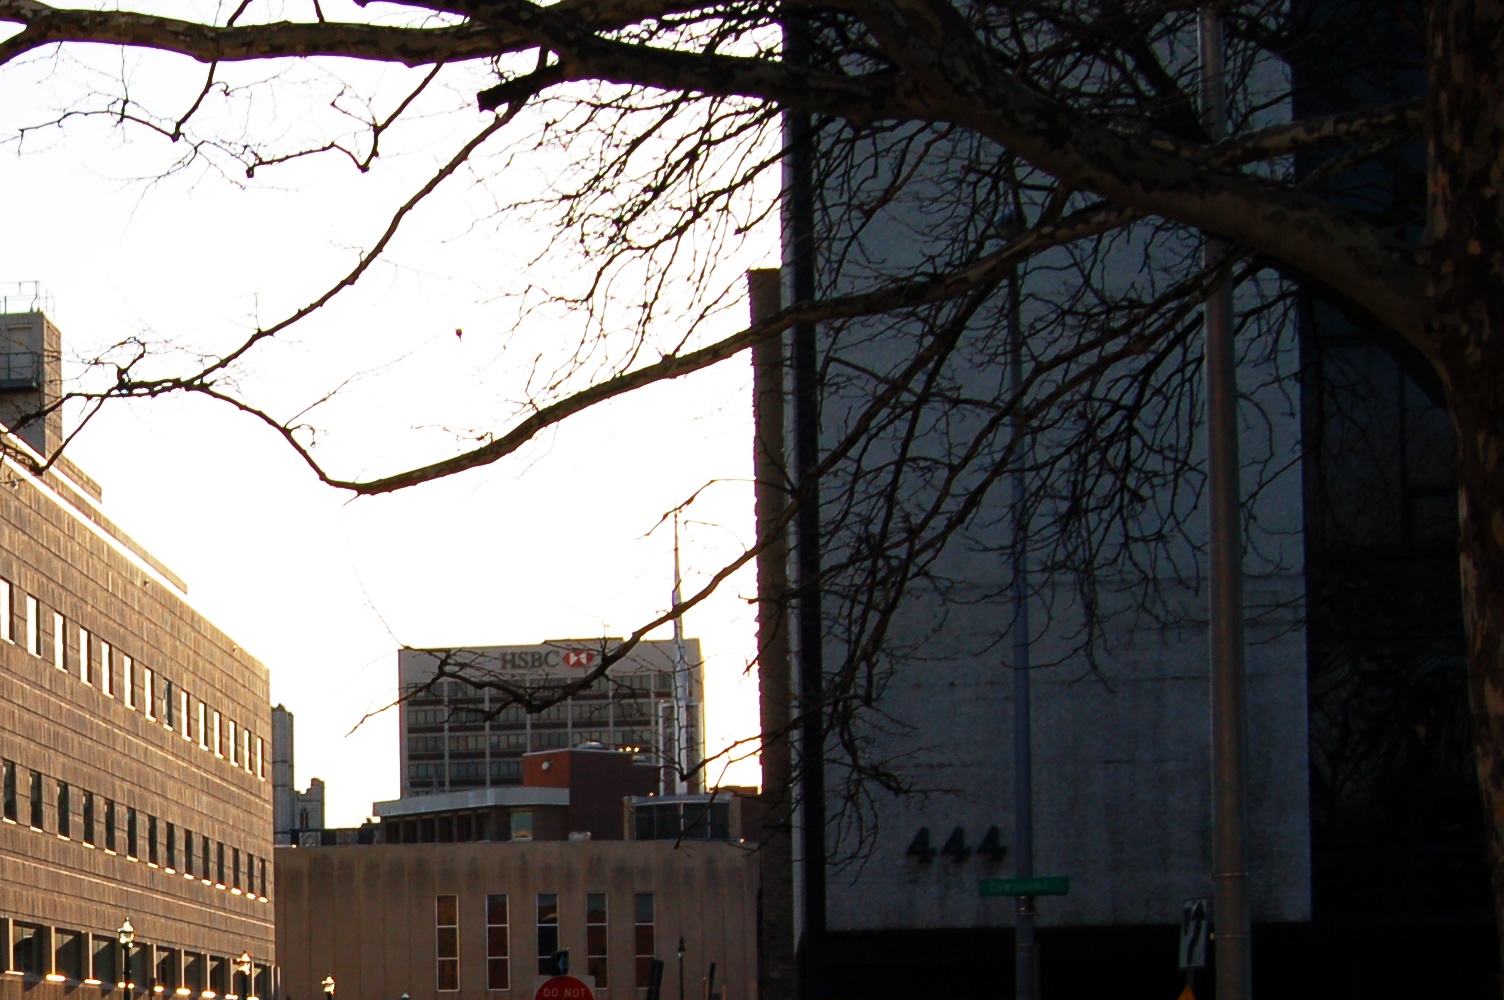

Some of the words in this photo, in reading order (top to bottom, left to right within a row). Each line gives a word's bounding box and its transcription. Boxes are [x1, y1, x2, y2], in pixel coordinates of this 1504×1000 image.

[500, 650, 560, 669] HSBC
[905, 825, 1007, 863] 444
[543, 988, 558, 997] DO
[564, 988, 586, 997] NOT
